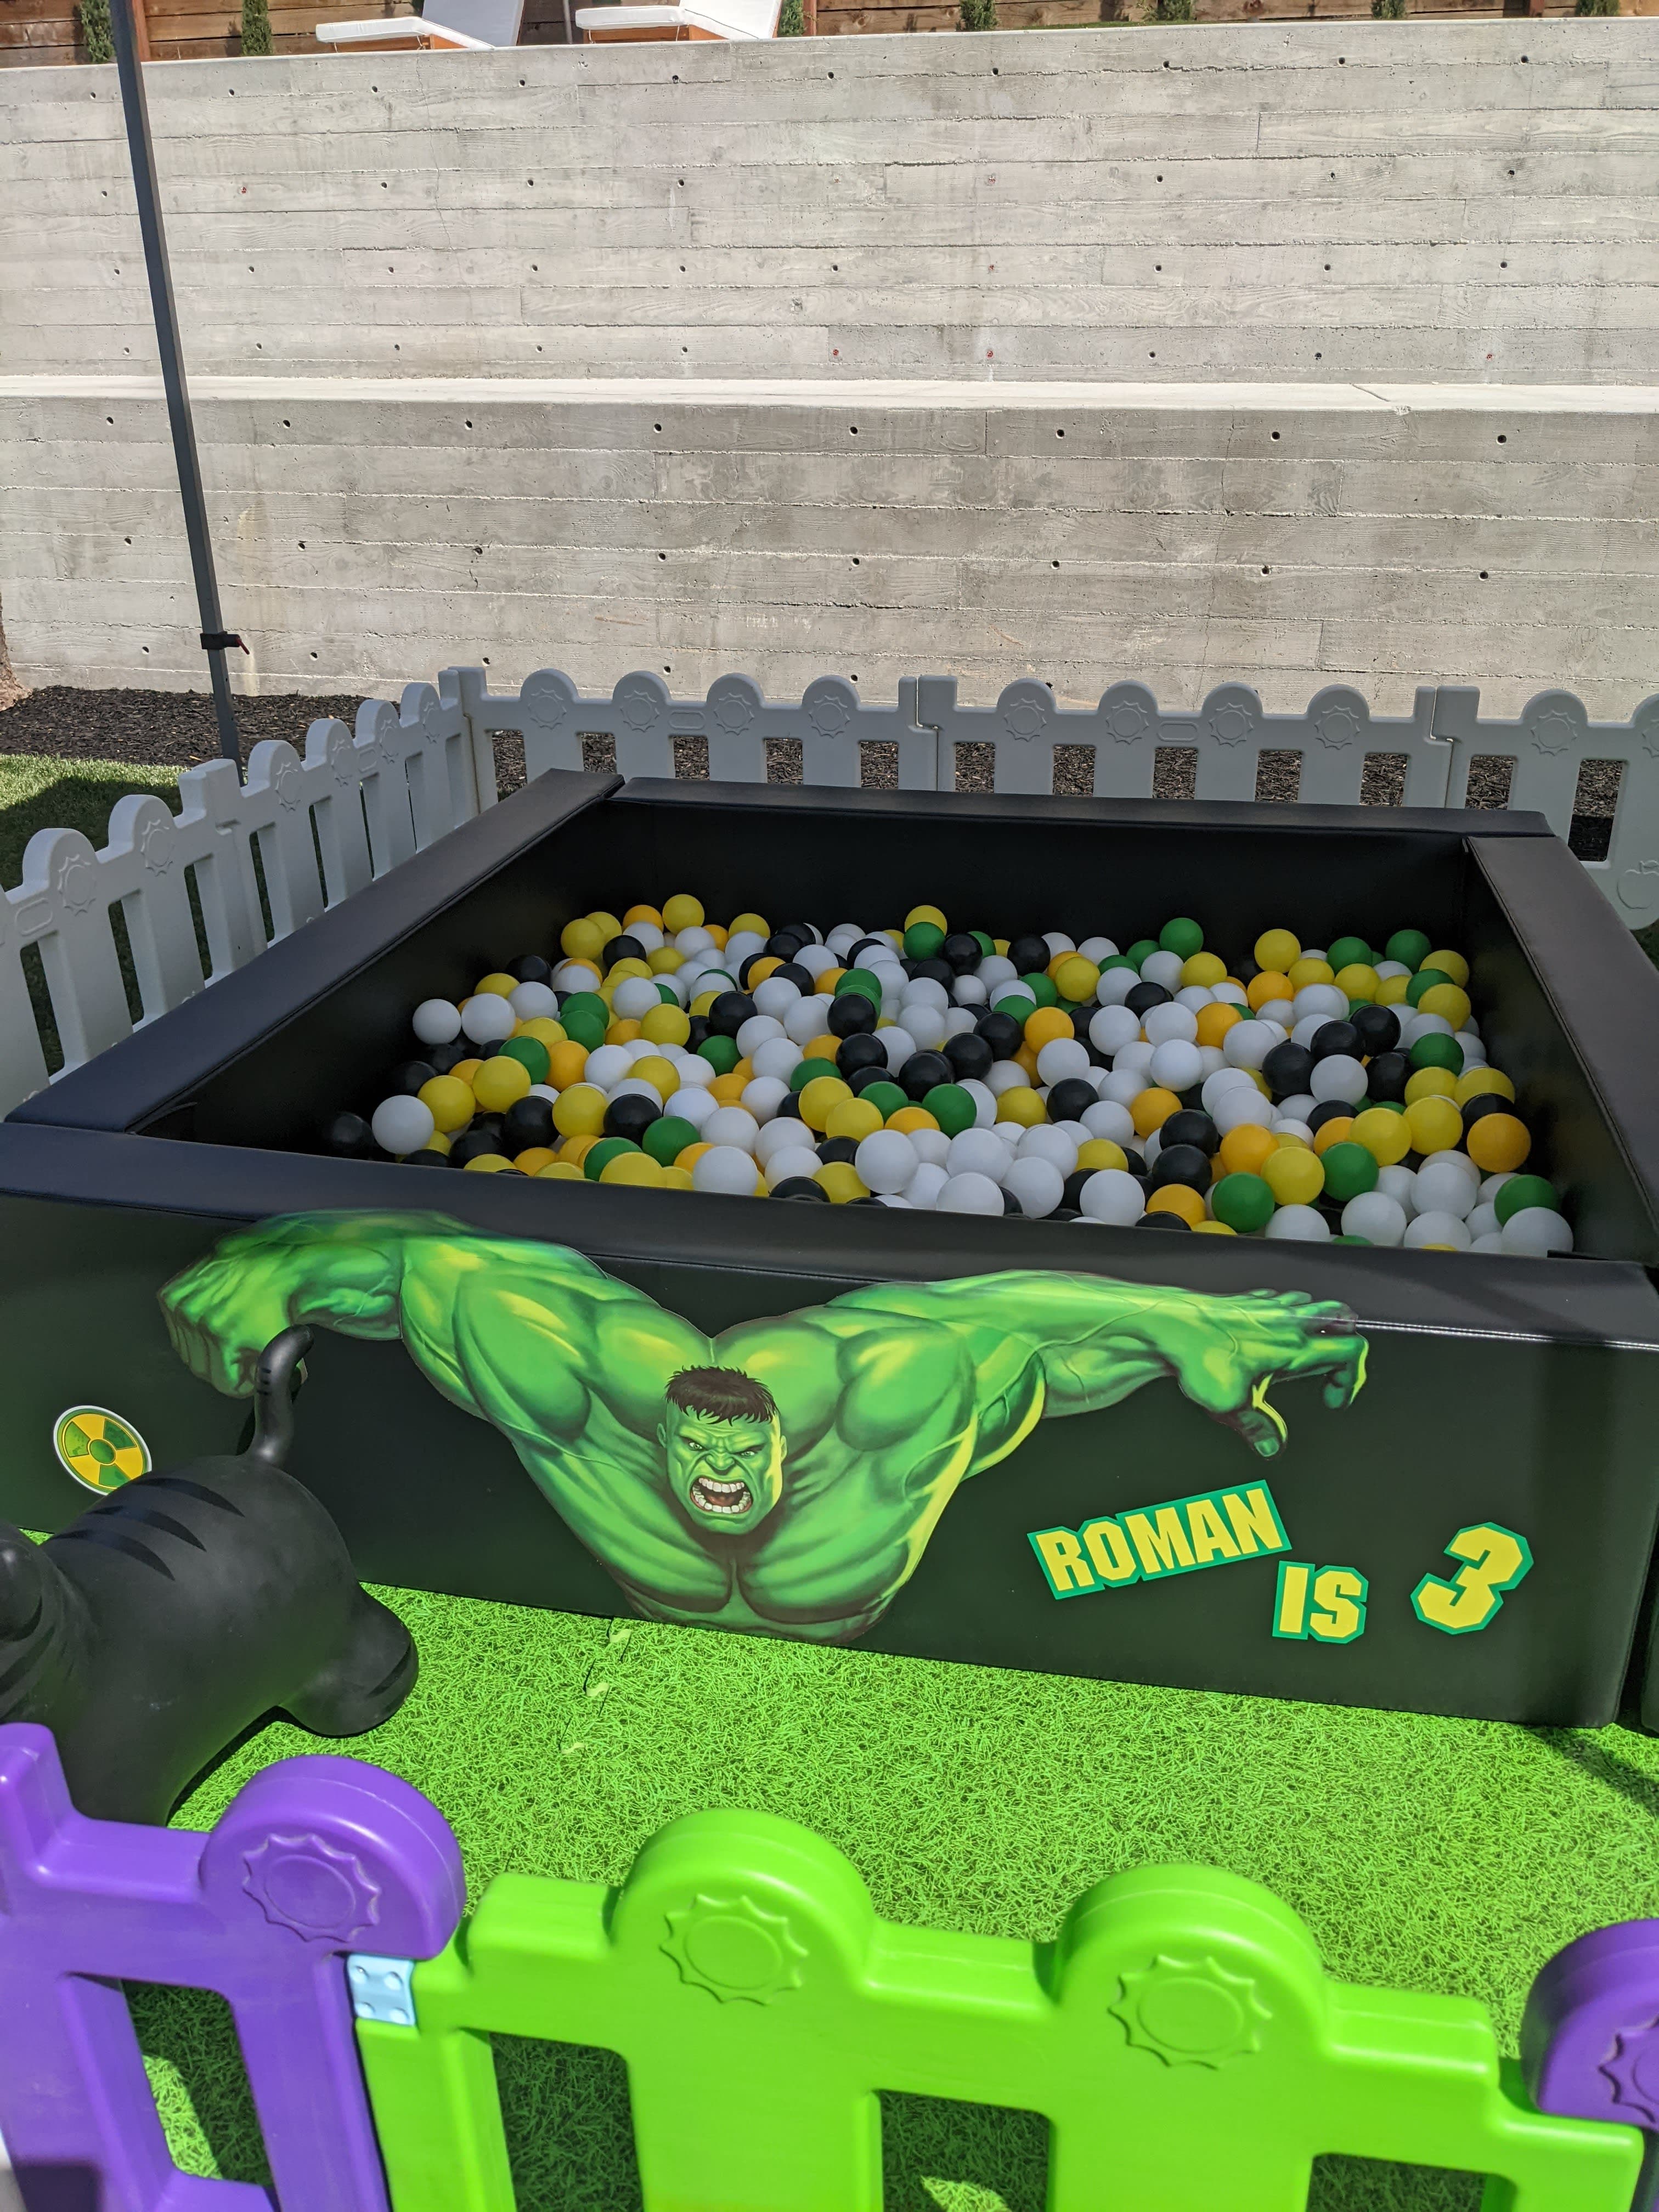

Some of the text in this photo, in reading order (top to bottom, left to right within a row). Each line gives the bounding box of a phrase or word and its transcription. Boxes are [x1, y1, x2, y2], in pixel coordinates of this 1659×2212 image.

[1032, 1485, 1528, 1641] ROMAN IS 3
